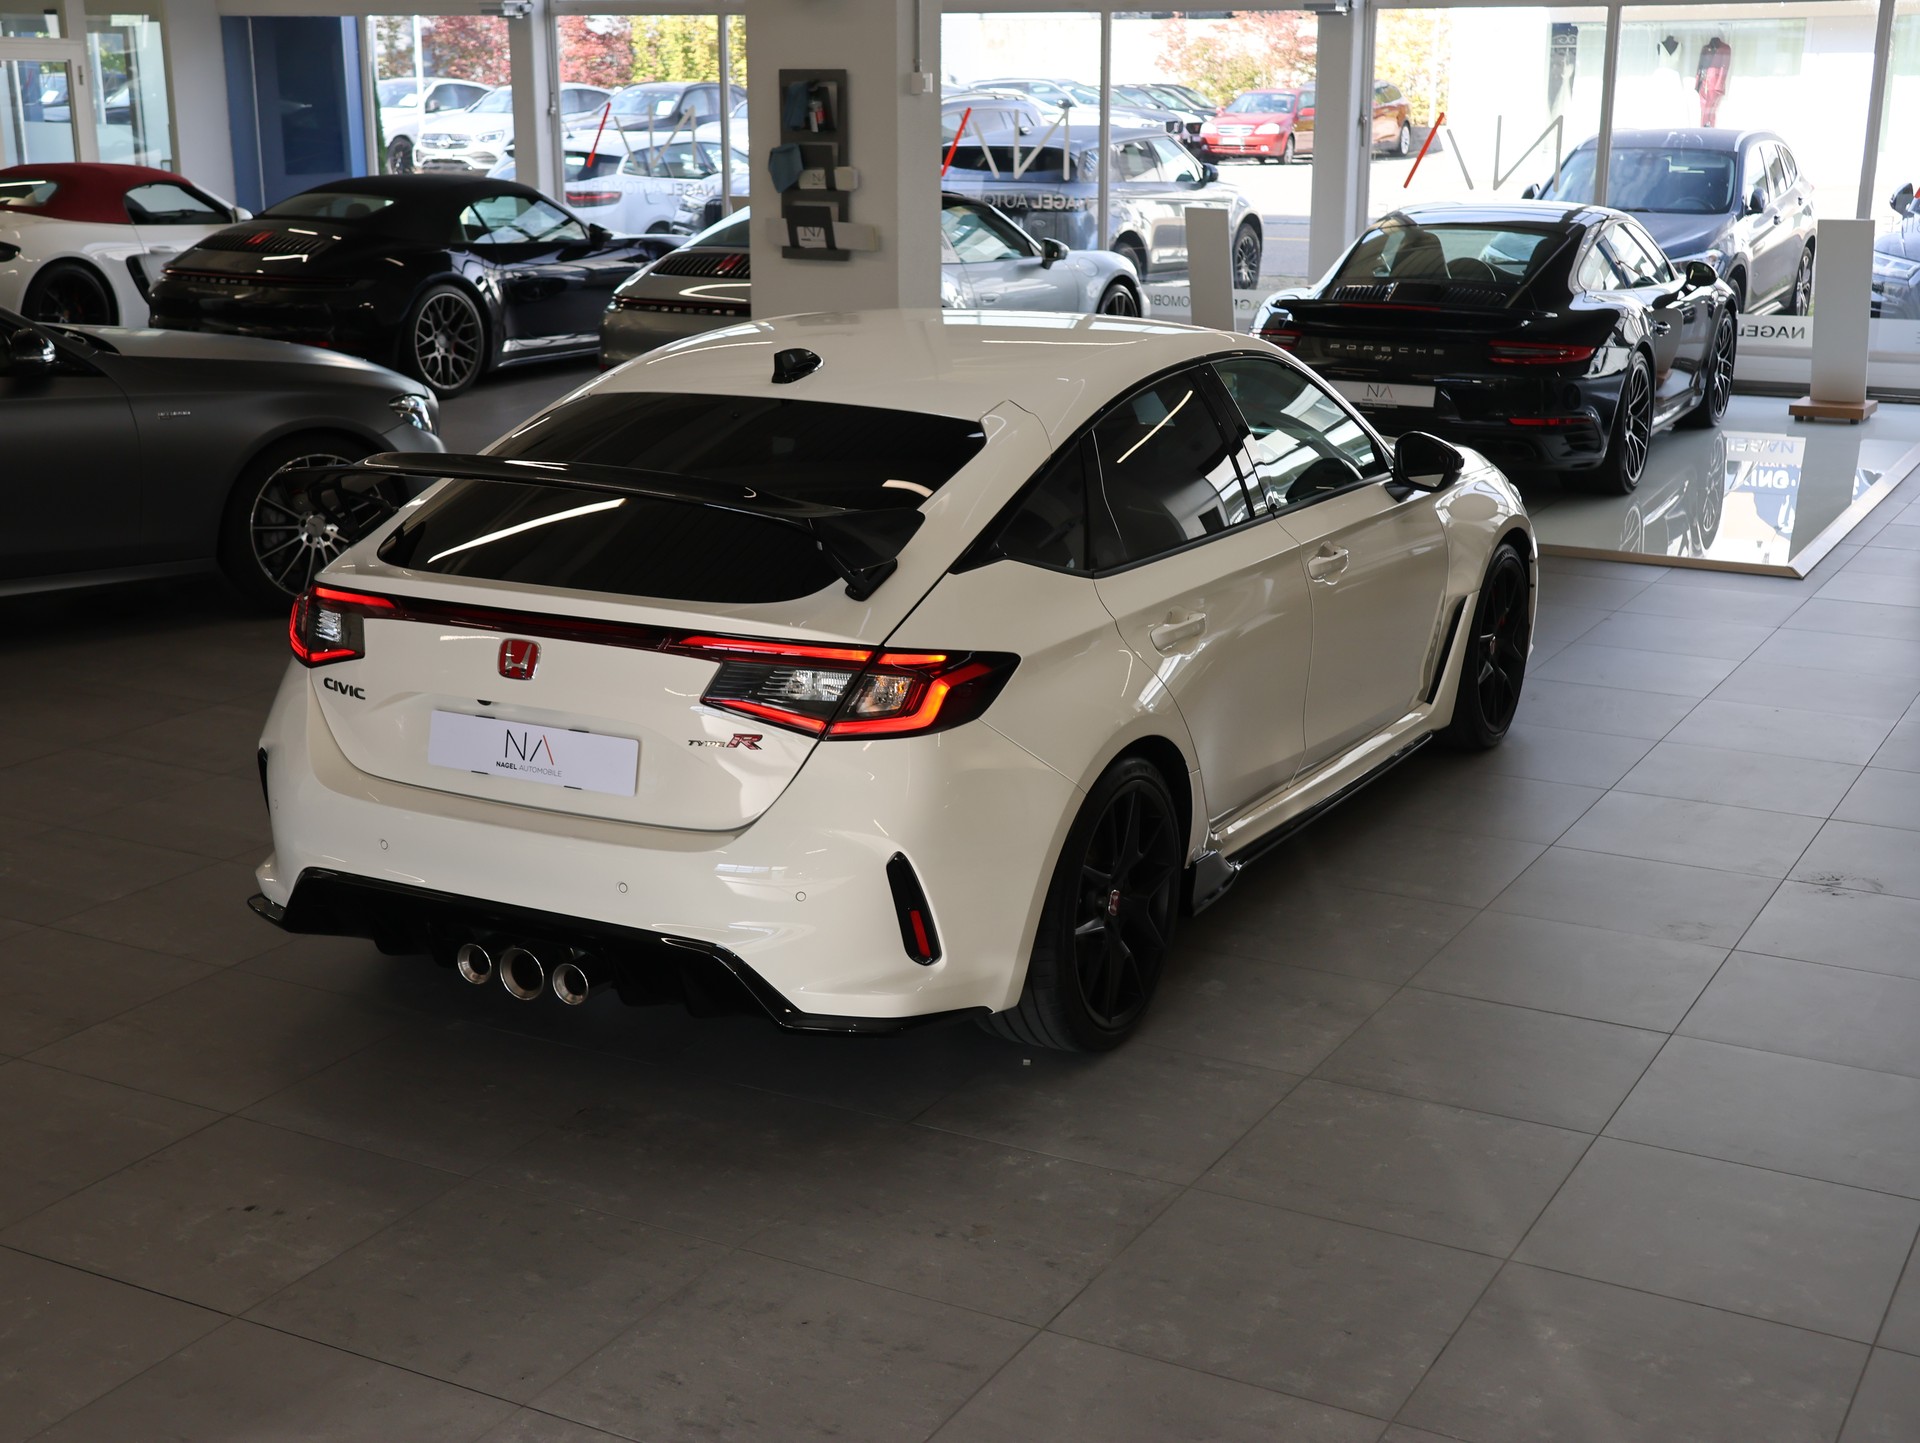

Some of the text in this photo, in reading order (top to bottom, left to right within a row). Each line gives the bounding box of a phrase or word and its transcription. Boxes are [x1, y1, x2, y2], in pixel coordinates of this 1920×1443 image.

[1330, 343, 1444, 355] PORSCHE
[323, 677, 366, 700] CIVIC
[688, 733, 763, 750] TYPE R
[496, 761, 562, 777] NAGEL AUTOMOBILE
